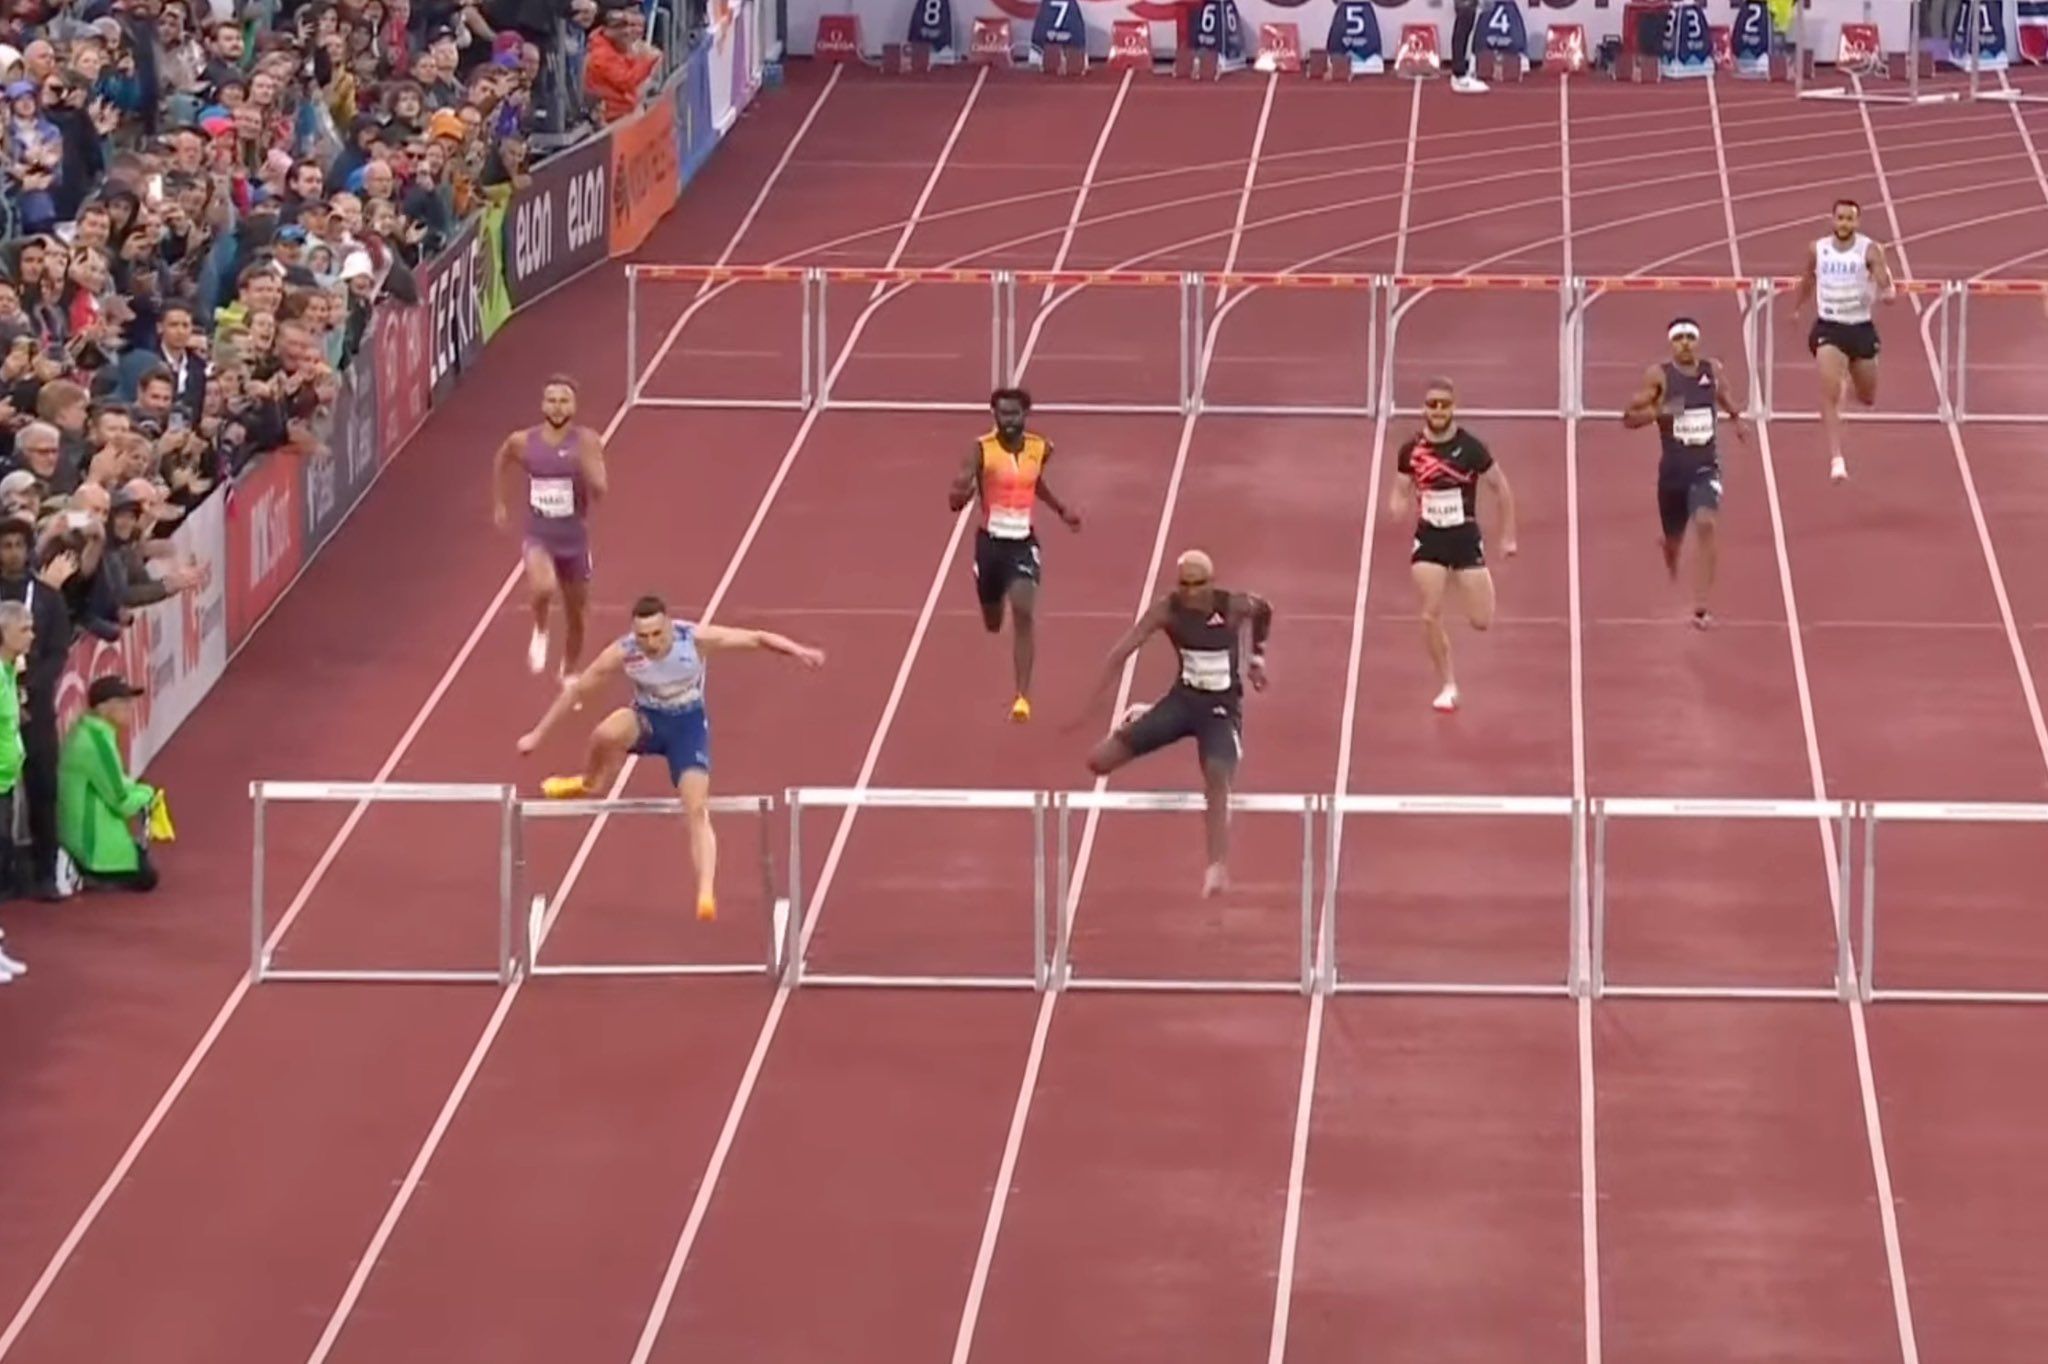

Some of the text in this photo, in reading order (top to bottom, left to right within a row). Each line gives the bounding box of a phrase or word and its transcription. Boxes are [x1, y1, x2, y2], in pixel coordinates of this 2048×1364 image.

[924, 0, 941, 26] 8
[1052, 1, 1069, 28] 7
[1201, 4, 1216, 33] 6
[1226, 4, 1237, 32] 6
[1346, 6, 1365, 35] 5
[1489, 5, 1511, 34] 4
[1664, 9, 1676, 37] 3
[1686, 9, 1701, 38] 3
[1745, 4, 1761, 32] 2
[1979, 4, 1993, 32] 1
[516, 189, 552, 282] elon
[567, 164, 604, 252] elon
